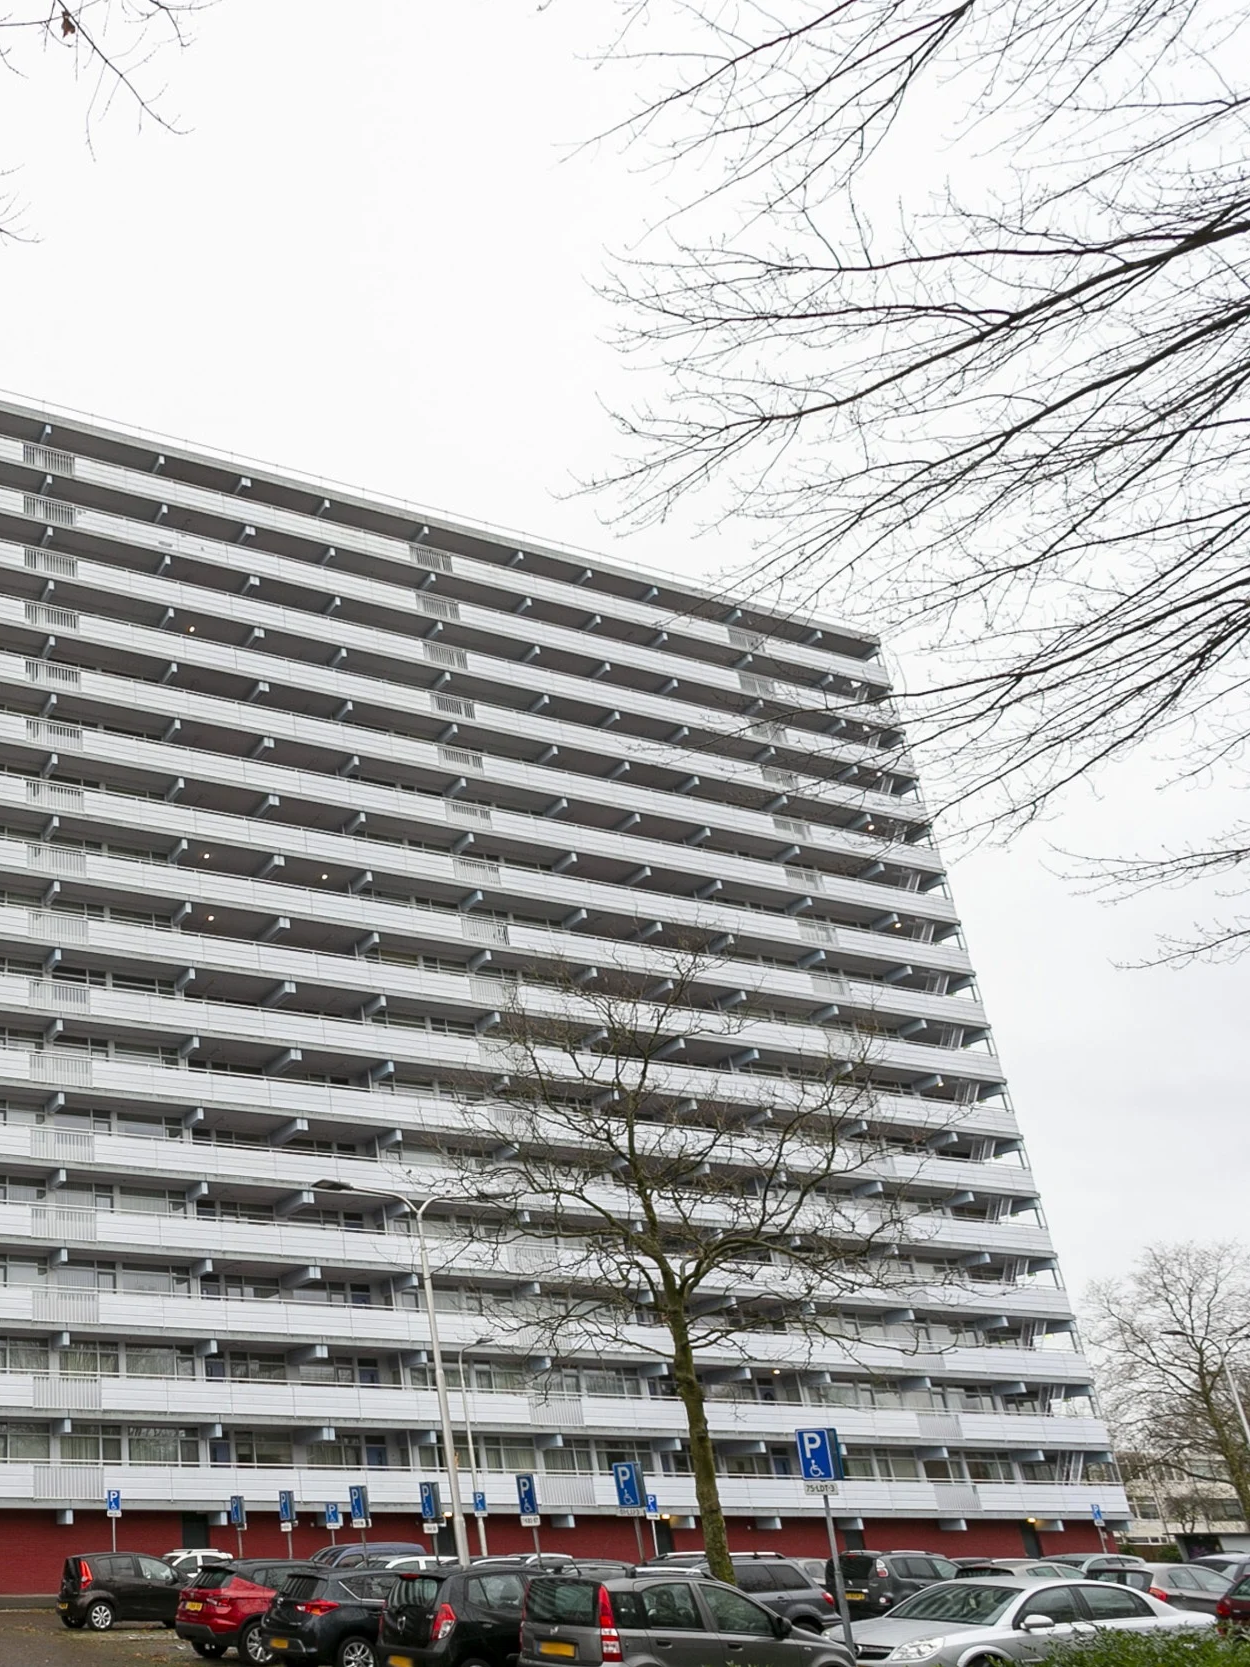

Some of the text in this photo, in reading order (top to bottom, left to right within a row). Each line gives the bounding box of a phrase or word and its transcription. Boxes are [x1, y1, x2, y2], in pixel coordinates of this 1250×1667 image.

[803, 1433, 821, 1458] P
[618, 1467, 630, 1489] P
[110, 1491, 118, 1502] P
[421, 1485, 429, 1503] P
[520, 1478, 530, 1498] P
[351, 1489, 359, 1506] P
[476, 1494, 483, 1504] P
[648, 1496, 655, 1506] P
[329, 1505, 336, 1515] P
